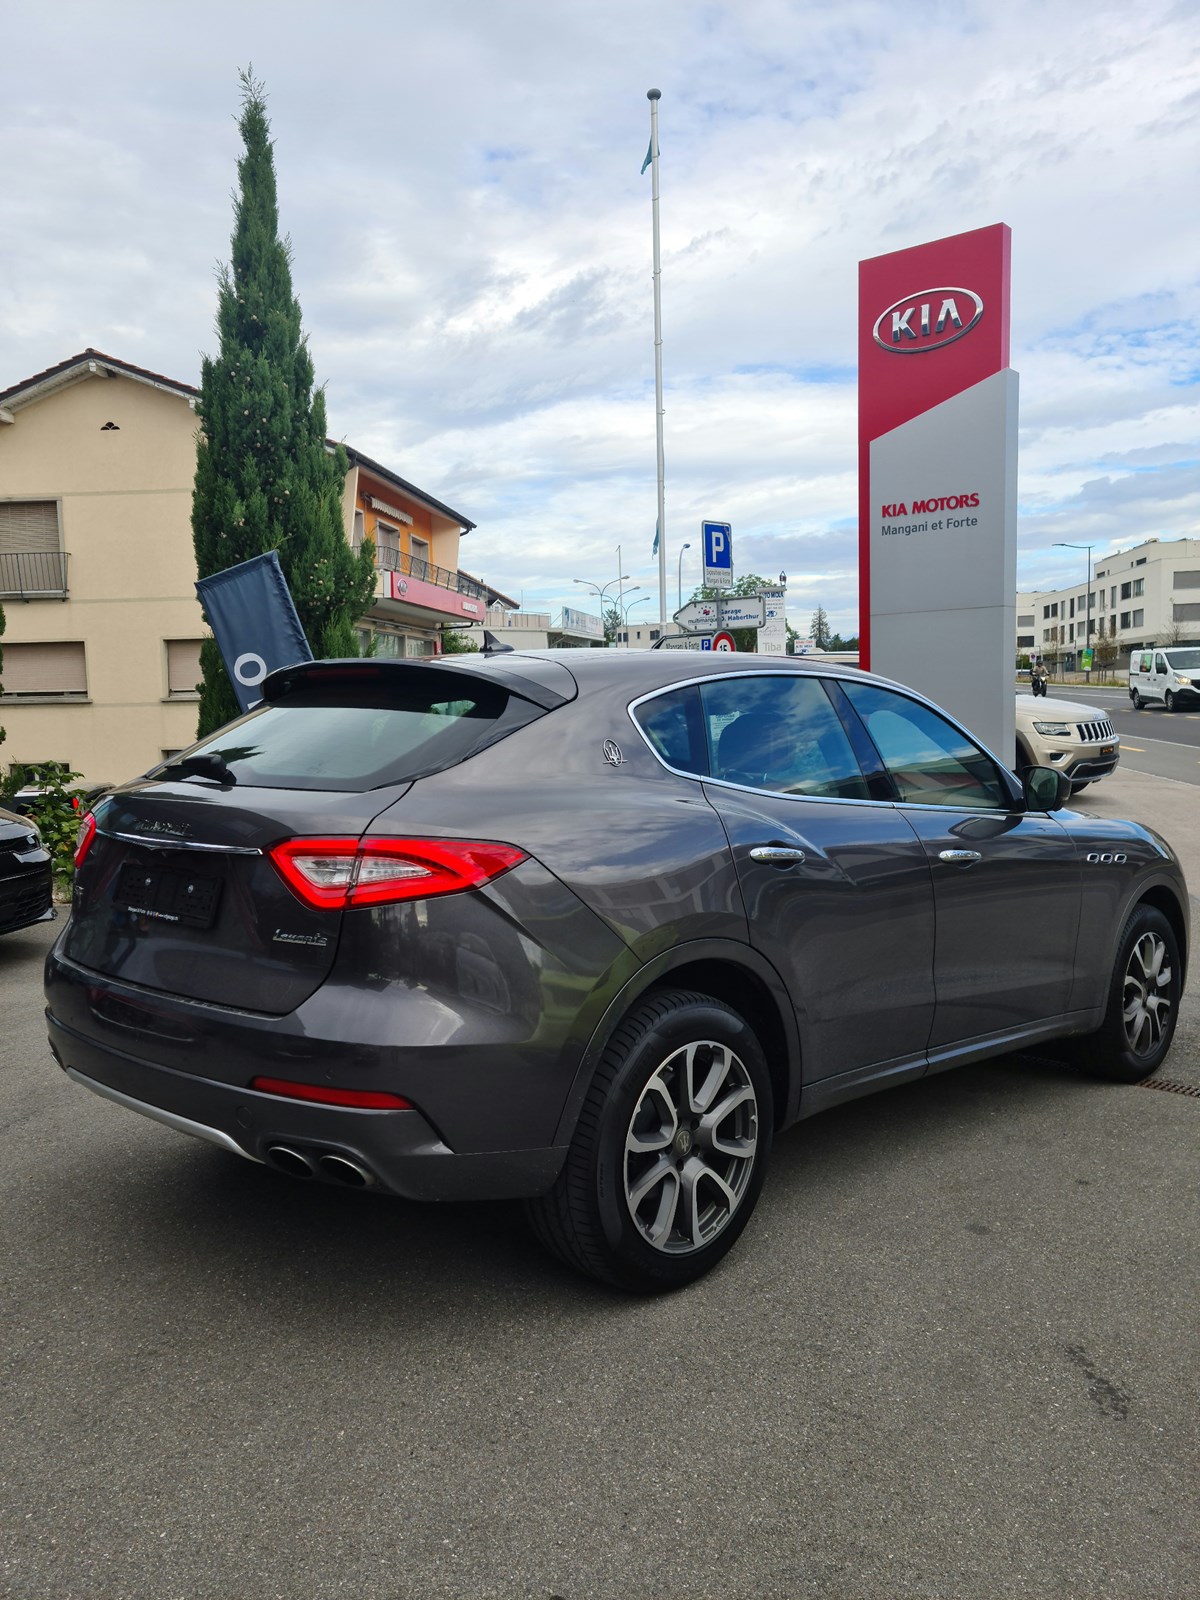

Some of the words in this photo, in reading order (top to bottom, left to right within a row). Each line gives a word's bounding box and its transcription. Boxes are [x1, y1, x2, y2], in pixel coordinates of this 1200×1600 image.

[891, 298, 963, 342] KIA
[881, 503, 907, 518] KIA
[911, 492, 980, 515] MOTORS
[881, 519, 928, 536] Mangani
[931, 517, 944, 531] et
[946, 516, 978, 530] Forte
[711, 531, 724, 563] P
[762, 642, 782, 652] Tiba
[234, 652, 267, 709] O
